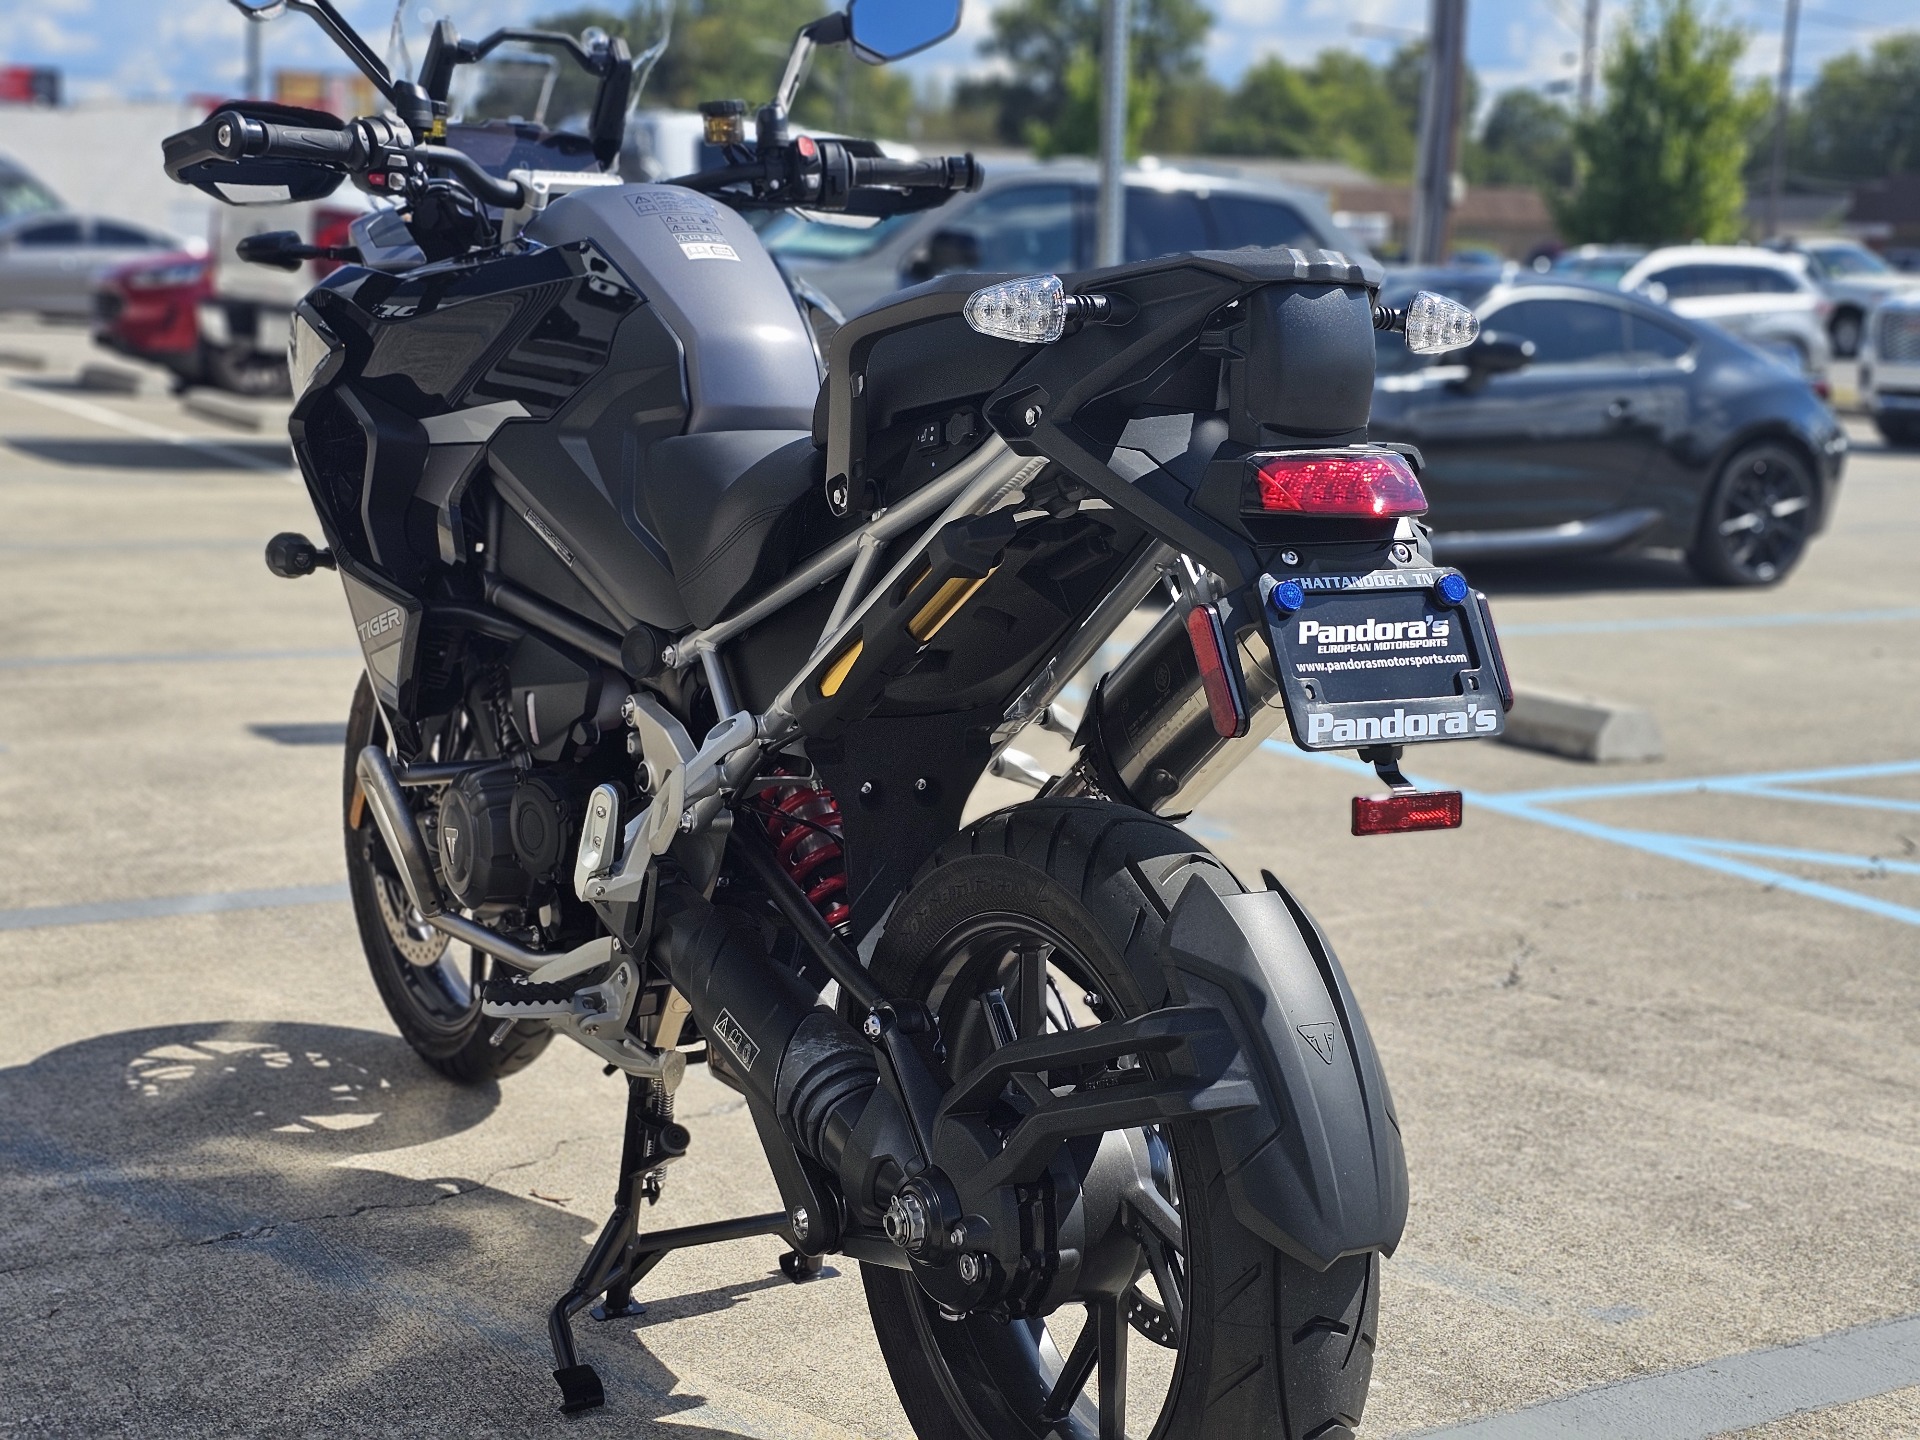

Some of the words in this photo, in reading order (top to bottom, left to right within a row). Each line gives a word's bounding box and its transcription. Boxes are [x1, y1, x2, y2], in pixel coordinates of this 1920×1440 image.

[1412, 573, 1435, 586] TN
[357, 608, 401, 642] TIGER
[1298, 615, 1450, 645] Pandora's
[1317, 642, 1372, 654] EUROPEAN
[1374, 638, 1449, 652] MOTORSPORTS
[1296, 653, 1468, 674] www.pandorasmotorsports.com
[1307, 703, 1497, 744] Pandora's
